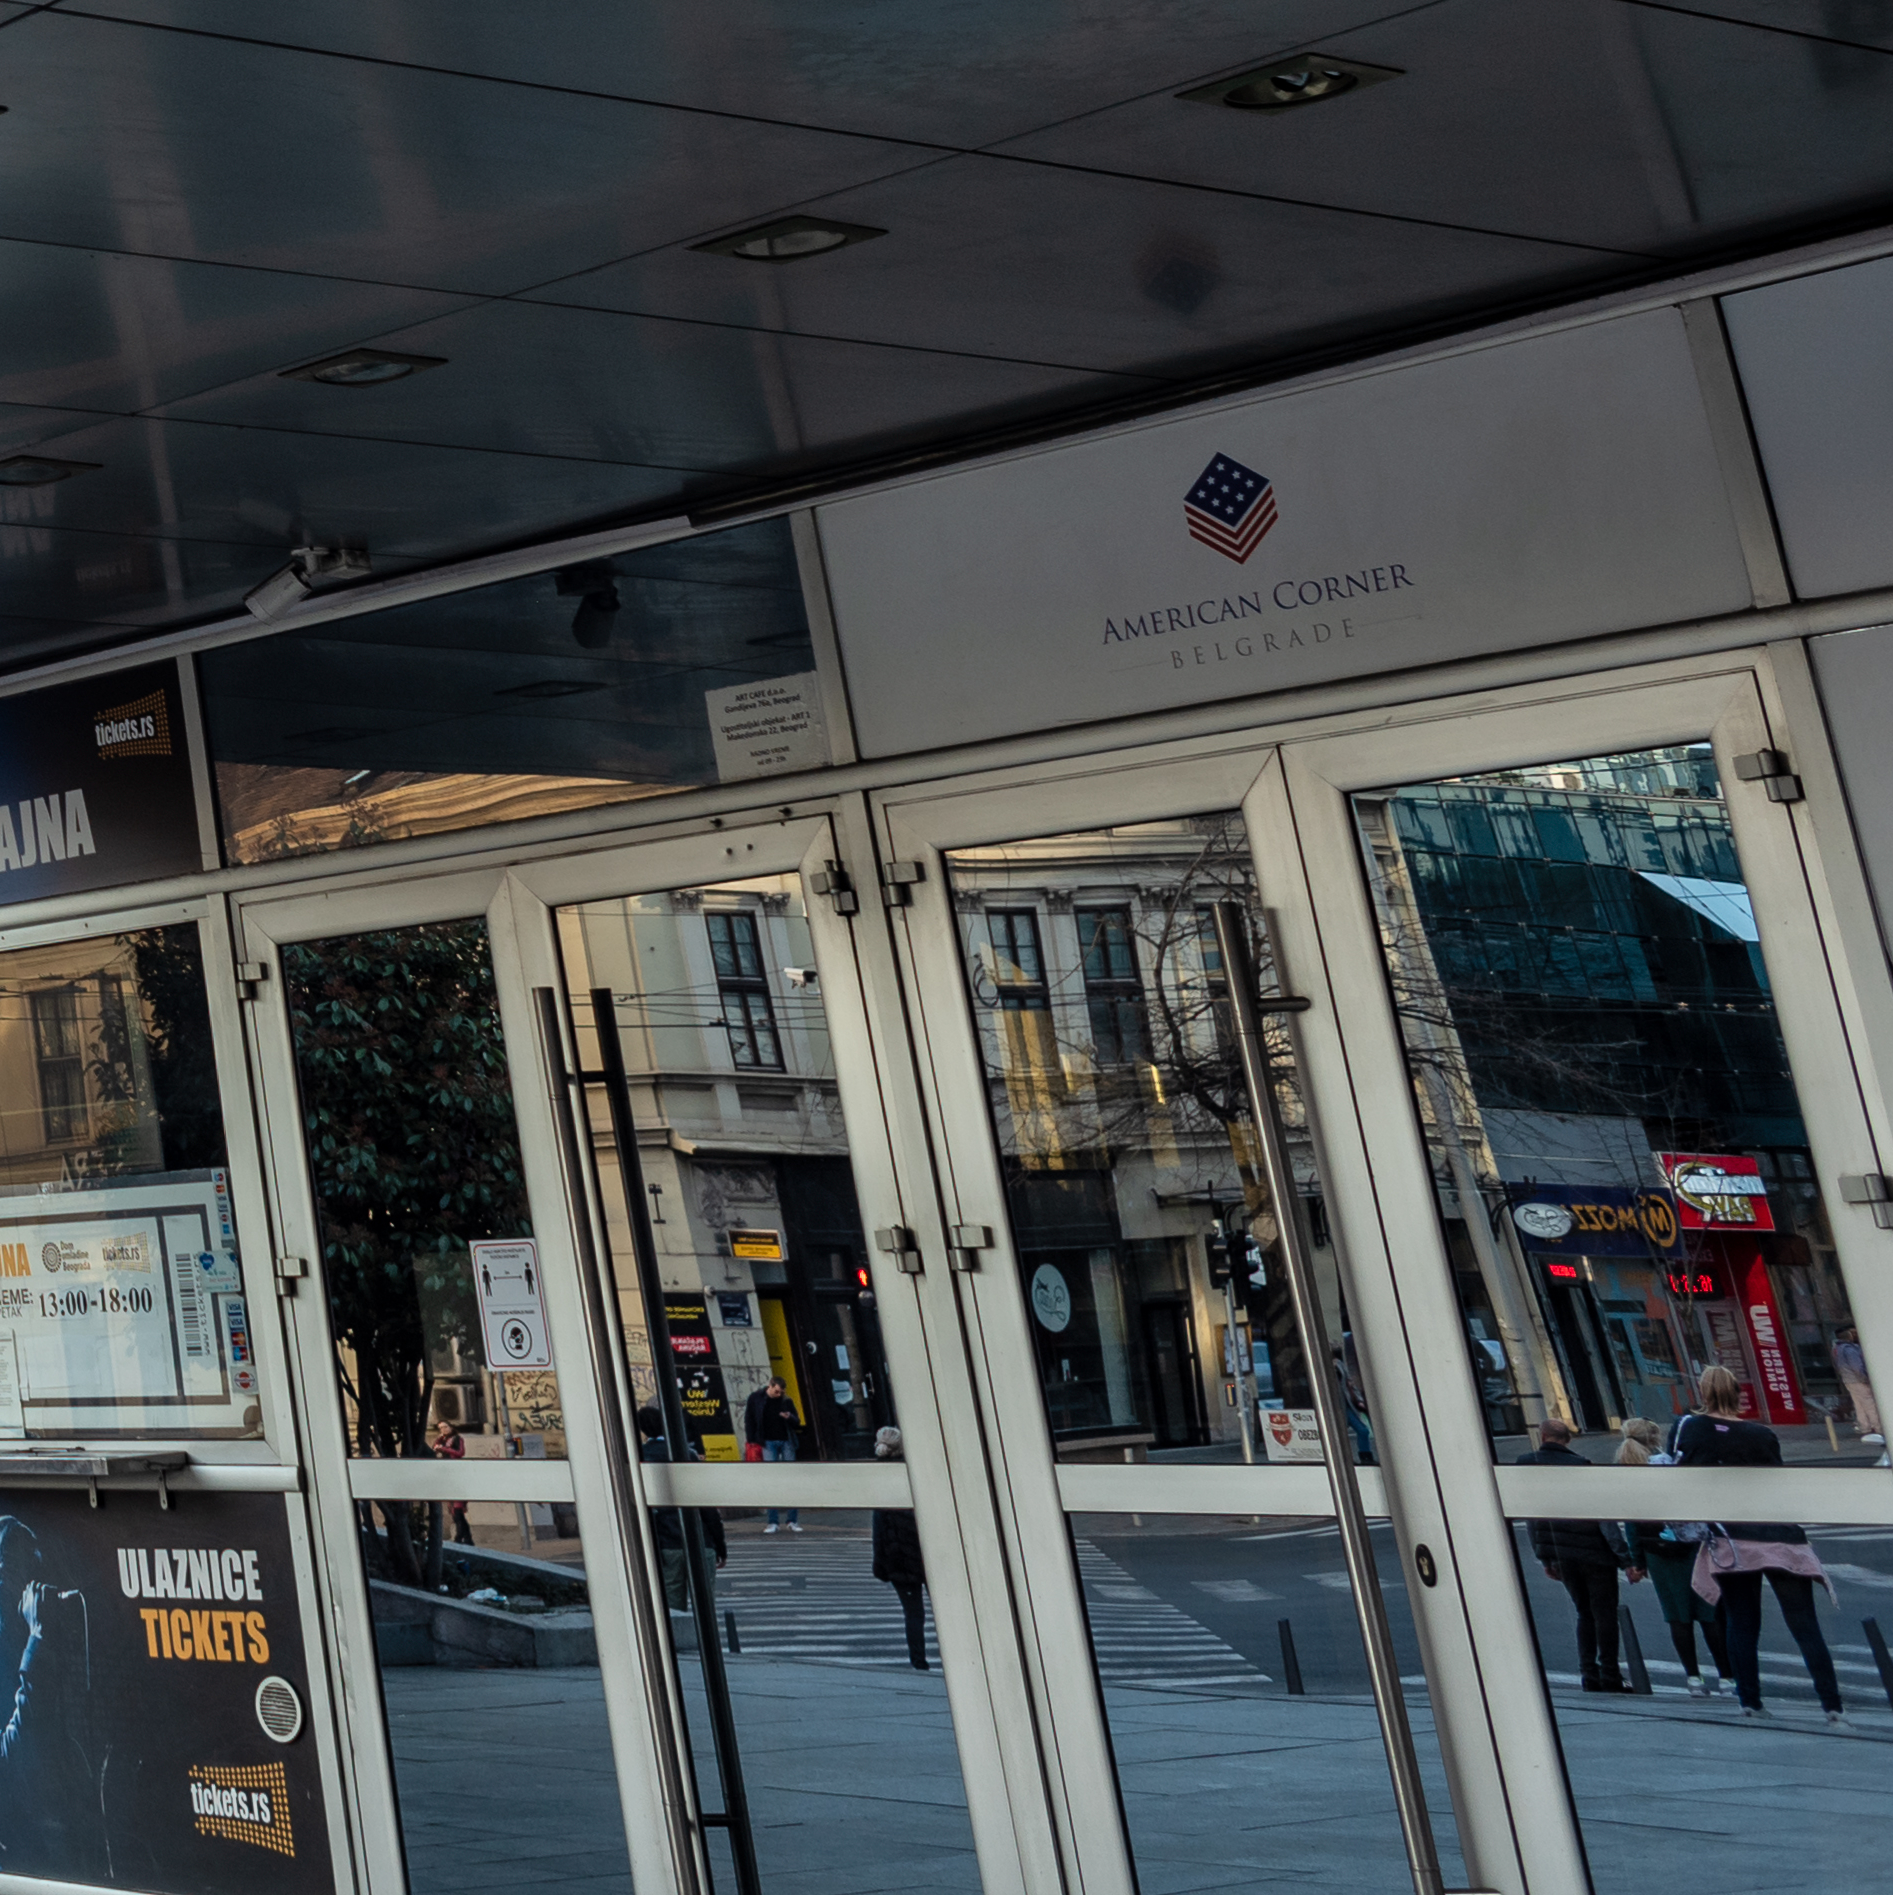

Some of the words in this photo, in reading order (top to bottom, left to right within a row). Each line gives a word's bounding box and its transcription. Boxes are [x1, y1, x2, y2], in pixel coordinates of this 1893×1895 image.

[1171, 618, 1355, 670] BELGRADE
[95, 715, 155, 747] tickets.rs
[117, 1548, 263, 1601] ULAZNICE
[139, 1608, 270, 1663] TICKETS
[190, 1782, 270, 1823] tickets.rs
